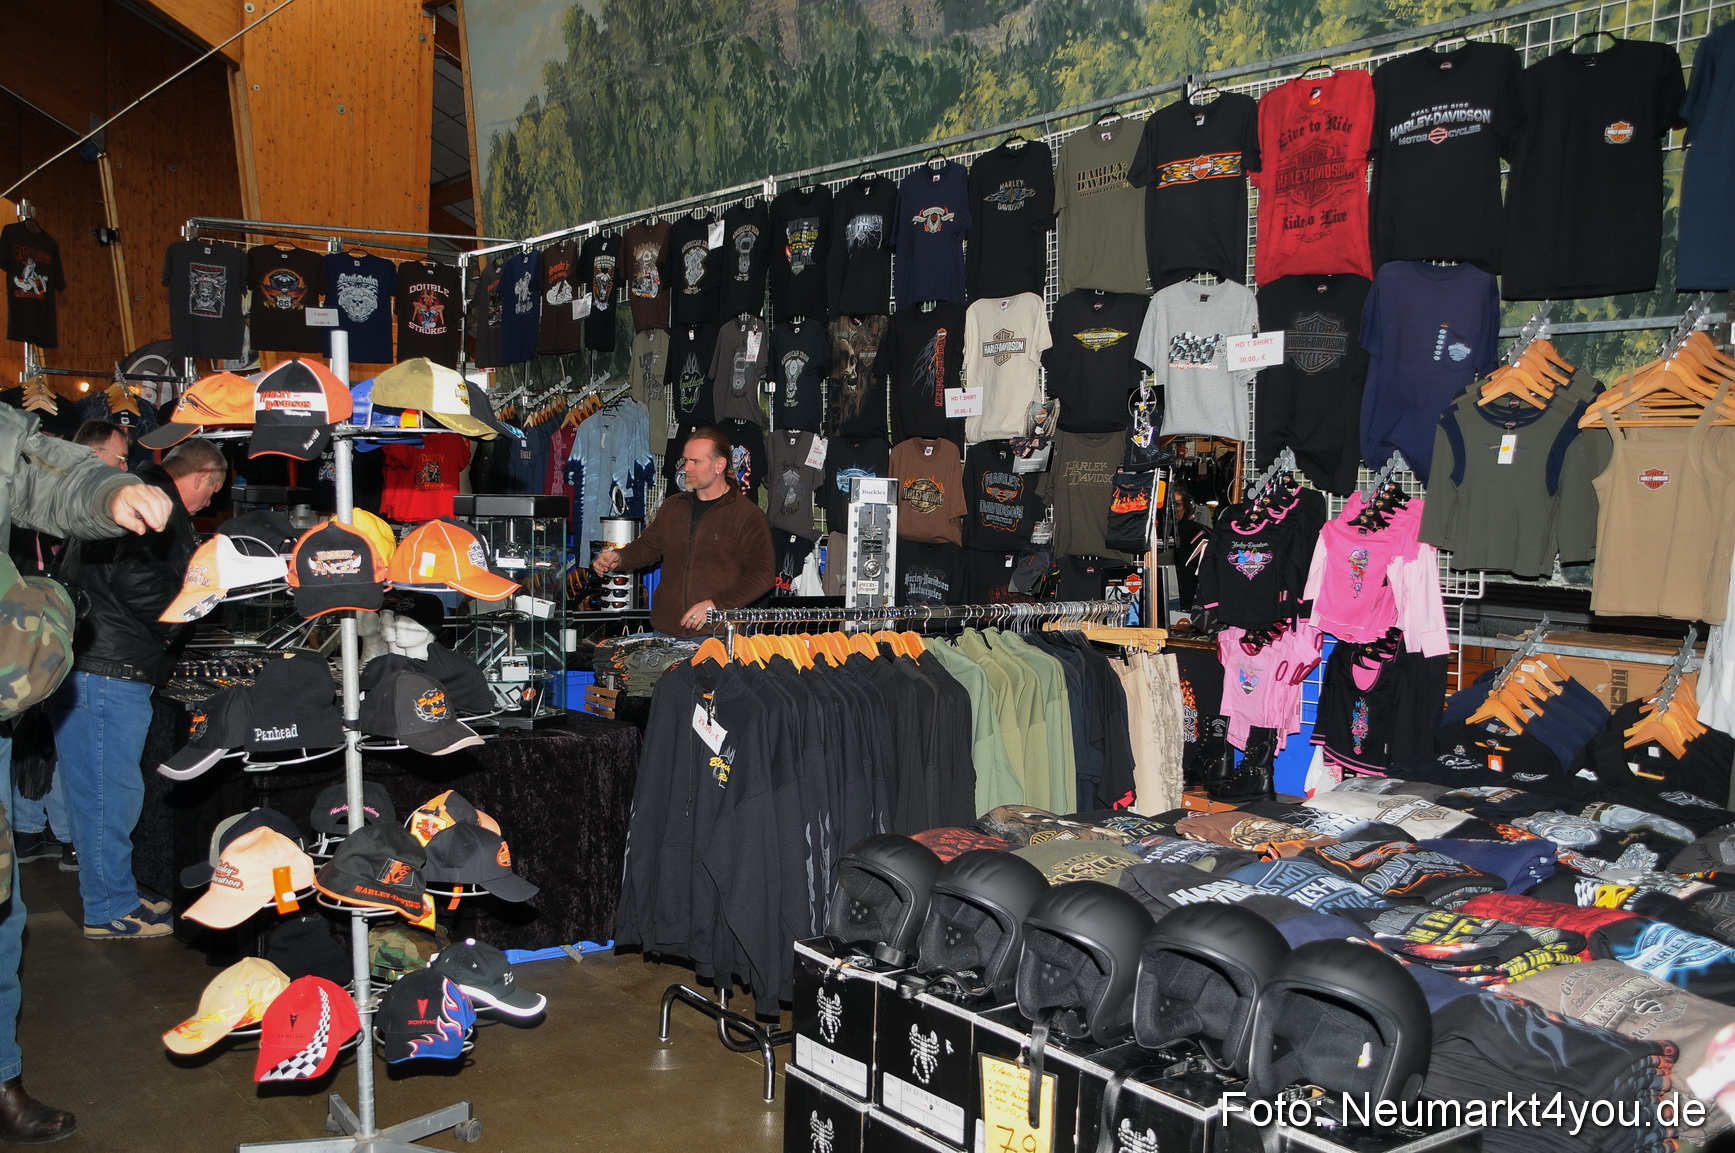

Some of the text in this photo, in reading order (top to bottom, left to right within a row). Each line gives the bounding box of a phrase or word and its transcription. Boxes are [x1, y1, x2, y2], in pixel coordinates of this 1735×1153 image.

[1411, 108, 1429, 117] REAL
[1432, 104, 1448, 112] MEN
[1277, 125, 1305, 148] Live
[1325, 115, 1353, 134] Ride
[1389, 109, 1491, 142] HARLEY-DAVIDSON
[1398, 124, 1481, 145] MOTOR CYCLES
[1077, 171, 1127, 192] DAVIDSO
[997, 200, 1025, 211] DAVIDSON
[408, 283, 450, 298] DOUBLE
[278, 300, 290, 308] 66
[408, 321, 448, 335] STROKED
[983, 341, 1025, 355] HARLEY-DAVIDSON
[1235, 340, 1246, 348] HD
[1252, 337, 1274, 346] SHIRT
[1286, 335, 1346, 351] HARLEY-DAVIDSON
[265, 400, 311, 411] DAVIDSON
[980, 500, 1024, 519] DAVIDSON
[315, 560, 360, 576] ANGEL
[254, 723, 299, 742] Panhead
